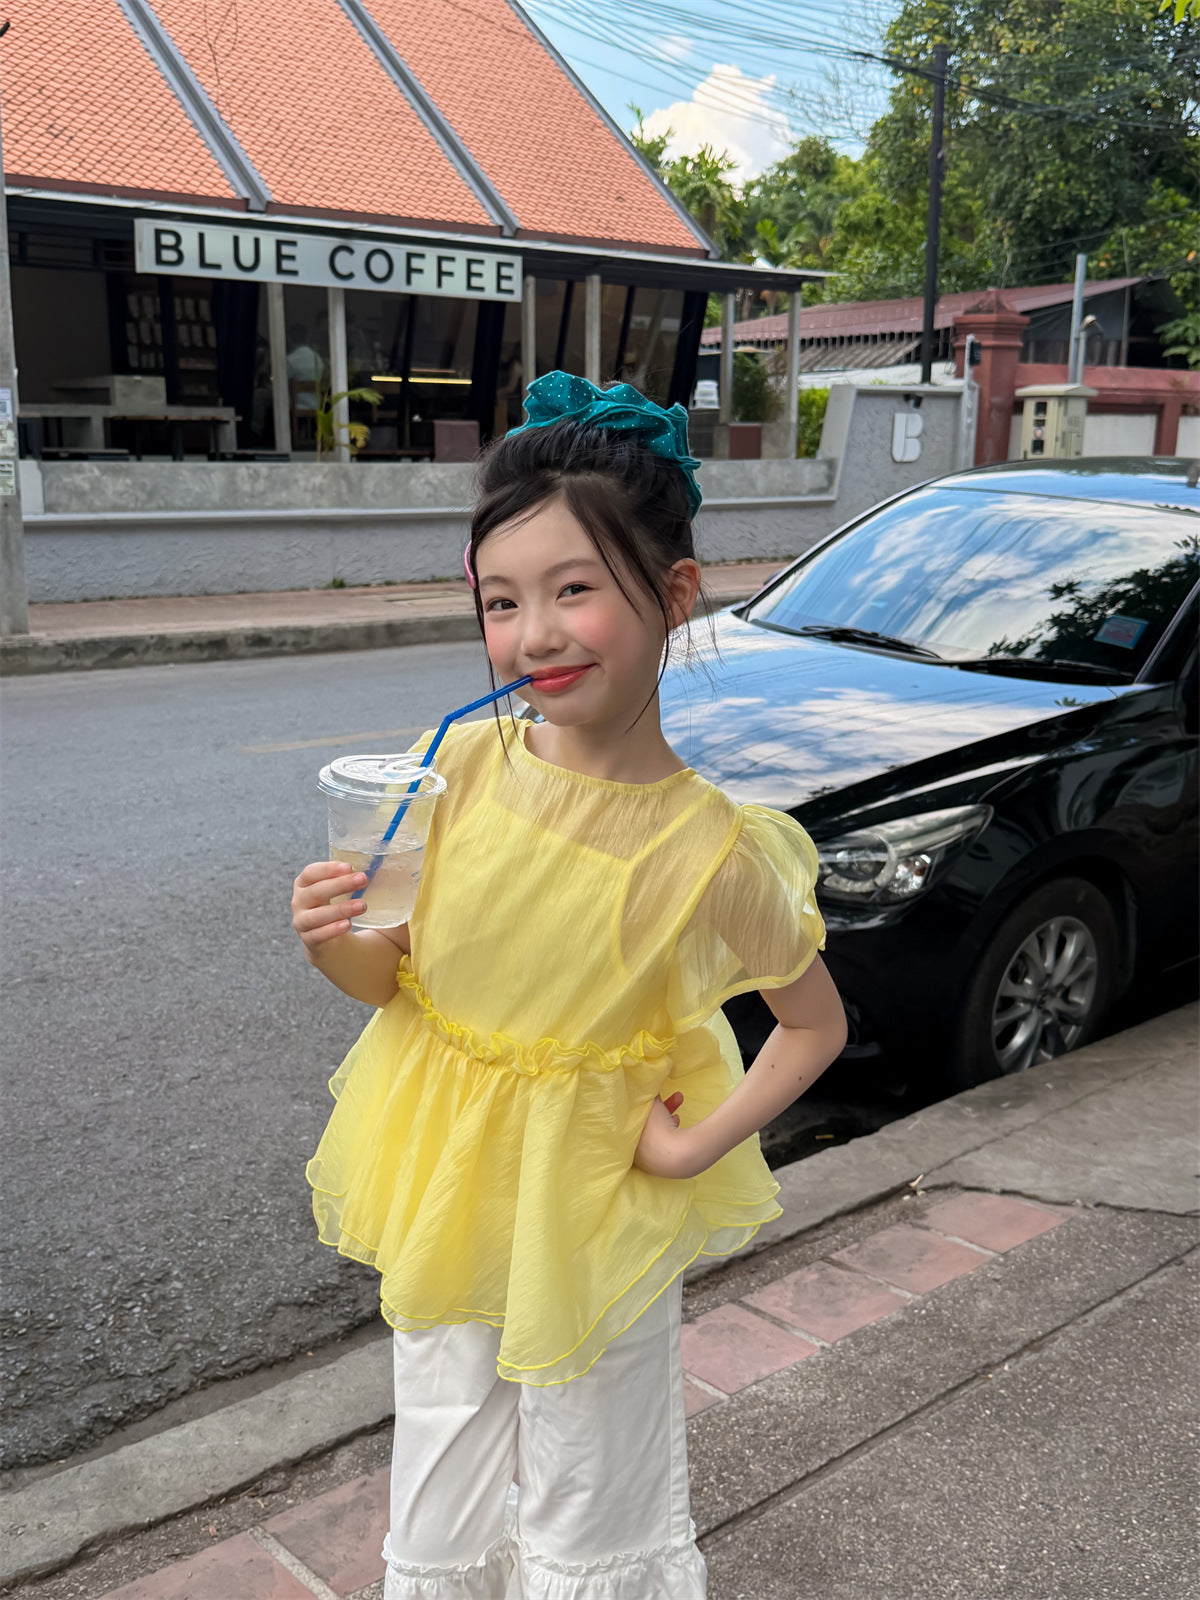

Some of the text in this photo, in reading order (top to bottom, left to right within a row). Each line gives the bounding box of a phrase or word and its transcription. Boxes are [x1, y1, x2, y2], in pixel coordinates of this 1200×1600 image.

[154, 228, 515, 295] BLUE COFFEE
[892, 412, 923, 463] B
